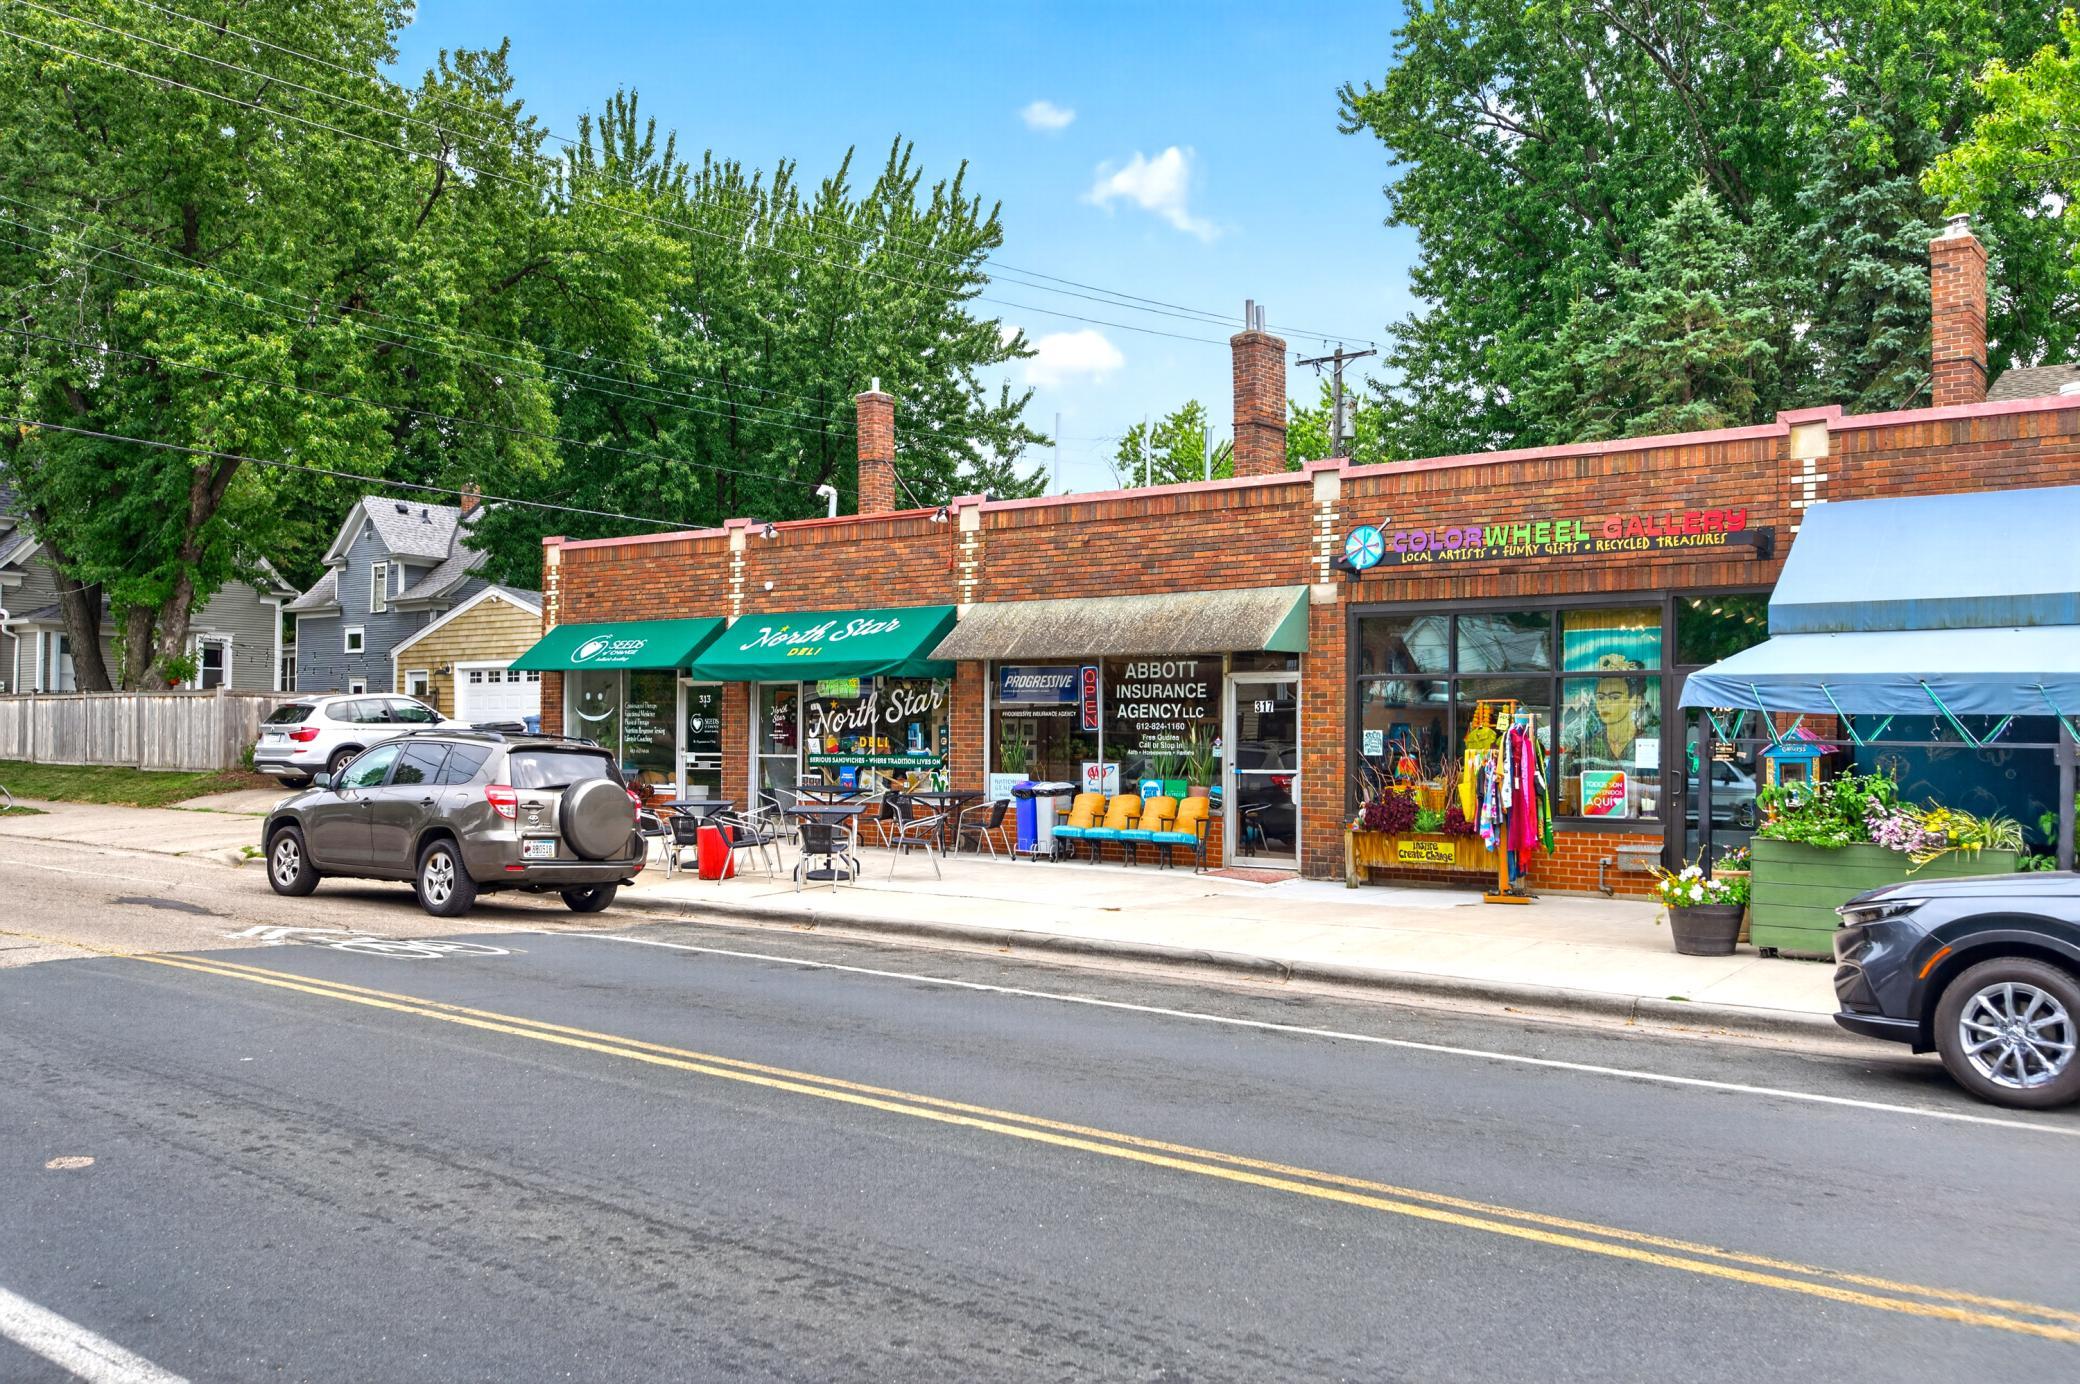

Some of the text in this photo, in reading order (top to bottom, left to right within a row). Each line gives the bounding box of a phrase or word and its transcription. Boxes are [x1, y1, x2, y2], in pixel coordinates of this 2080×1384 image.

[1603, 508, 1747, 539] GALLERY
[1402, 533, 1728, 564] LOCAL ARTISTS FUNKY GIFTS RECYCLED TREASURES
[739, 618, 901, 650] North Star
[608, 639, 648, 649] SEEDS
[786, 647, 822, 656] DELI
[1125, 660, 1198, 679] ABBOTT
[1004, 675, 1073, 688] PROGRESSIVE
[1116, 683, 1207, 699] INSURANCE
[699, 695, 711, 703] 313
[1084, 670, 1097, 728] OPEN
[808, 691, 880, 738] North
[885, 688, 943, 724] Star
[1117, 703, 1204, 718] AGENCY LLC
[1255, 701, 1273, 712] 317
[1136, 722, 1185, 730] 612-824-1160
[859, 737, 888, 748] DELI
[1139, 741, 1151, 749] Call
[1160, 741, 1175, 750] Stop
[1399, 849, 1453, 862] Create Change
